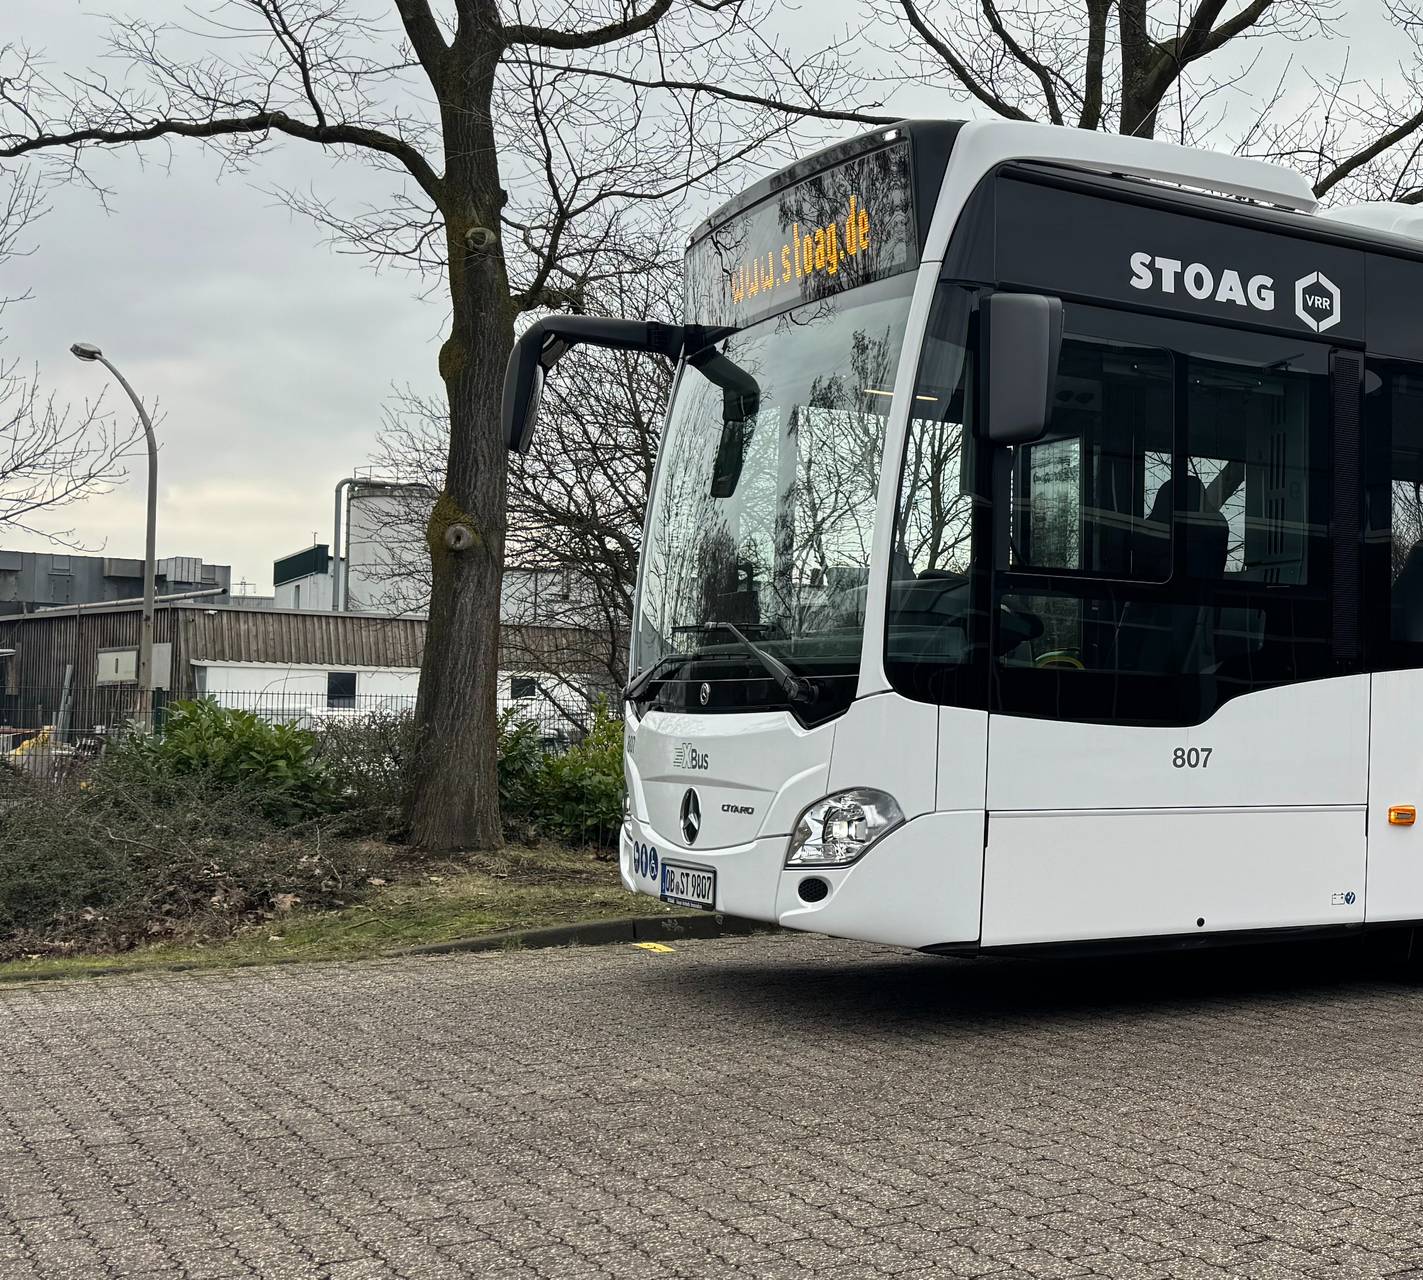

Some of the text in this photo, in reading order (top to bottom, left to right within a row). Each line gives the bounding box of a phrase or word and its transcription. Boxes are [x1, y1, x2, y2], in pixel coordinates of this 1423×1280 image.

[731, 194, 870, 305] www.stoag.de
[1129, 251, 1275, 311] STOAG
[1305, 294, 1331, 311] VRR
[681, 742, 709, 770] XBus
[1172, 747, 1213, 768] 807
[666, 869, 712, 900] OB ST 9807
